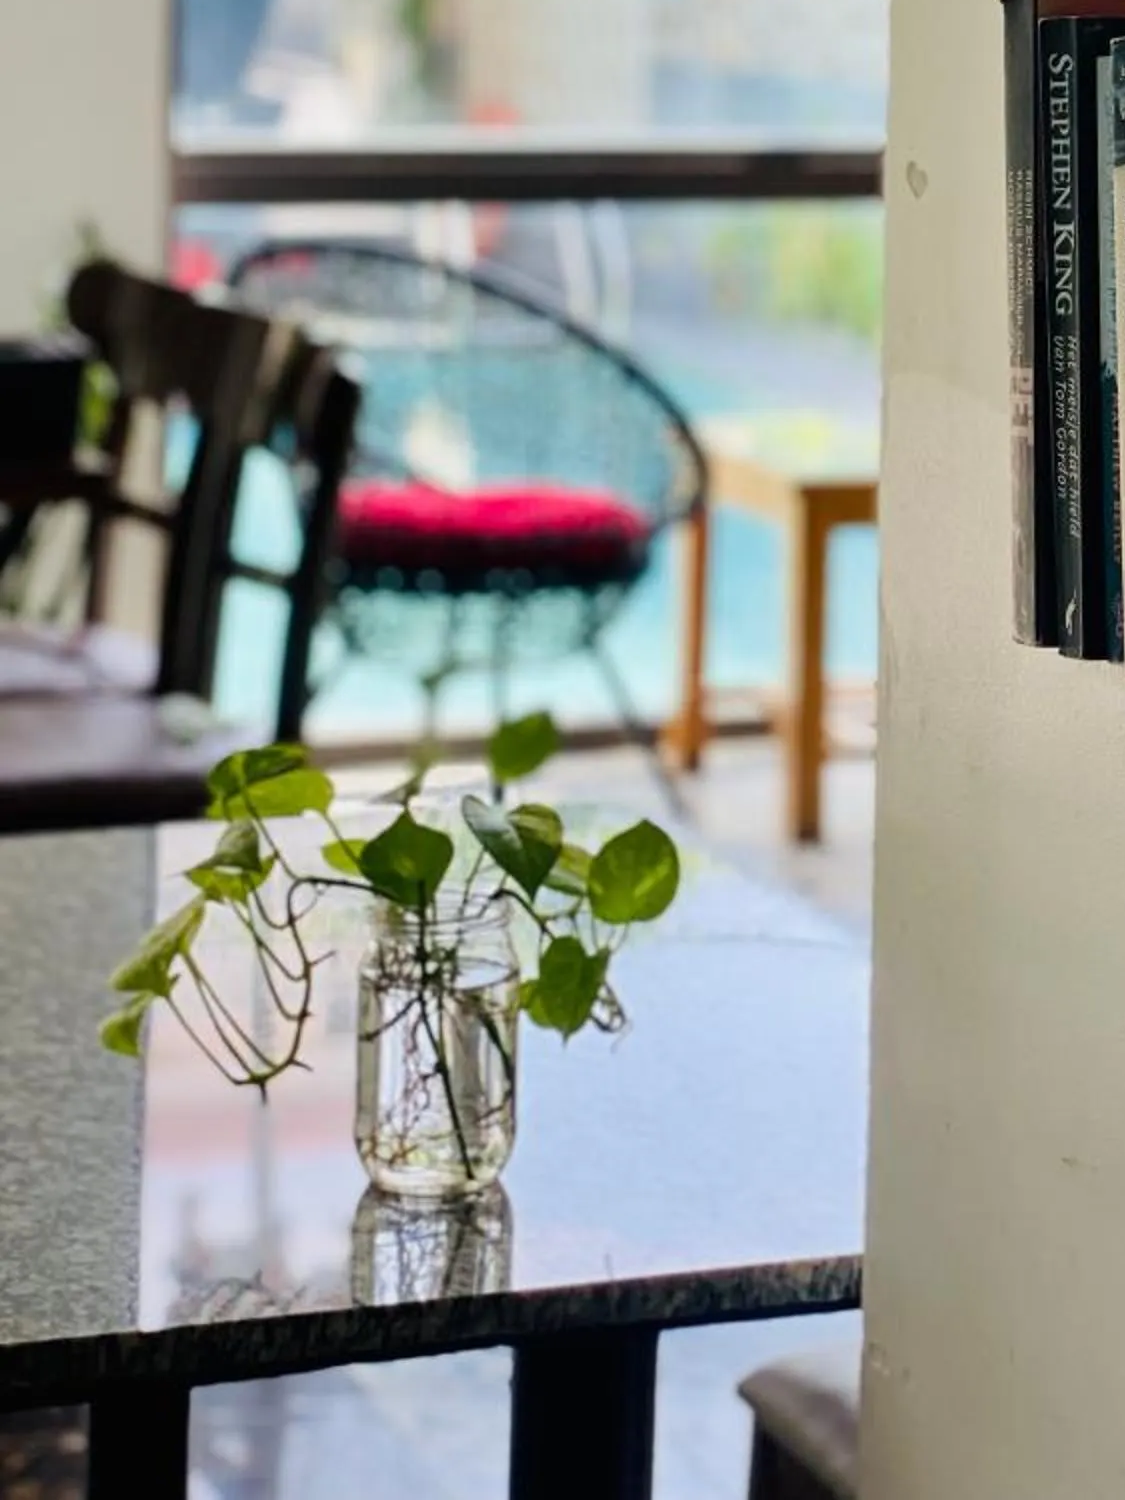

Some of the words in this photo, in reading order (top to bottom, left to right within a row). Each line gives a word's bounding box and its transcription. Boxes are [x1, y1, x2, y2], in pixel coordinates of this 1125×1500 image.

[1049, 52, 1074, 210] STEPHEN
[1053, 219, 1075, 316] KING
[1067, 335, 1079, 369] Het
[1055, 379, 1068, 421] Tom
[1063, 376, 1080, 441] meisje
[1055, 426, 1070, 501] Gordon
[1067, 445, 1081, 481] dat
[1067, 486, 1082, 540] hield
